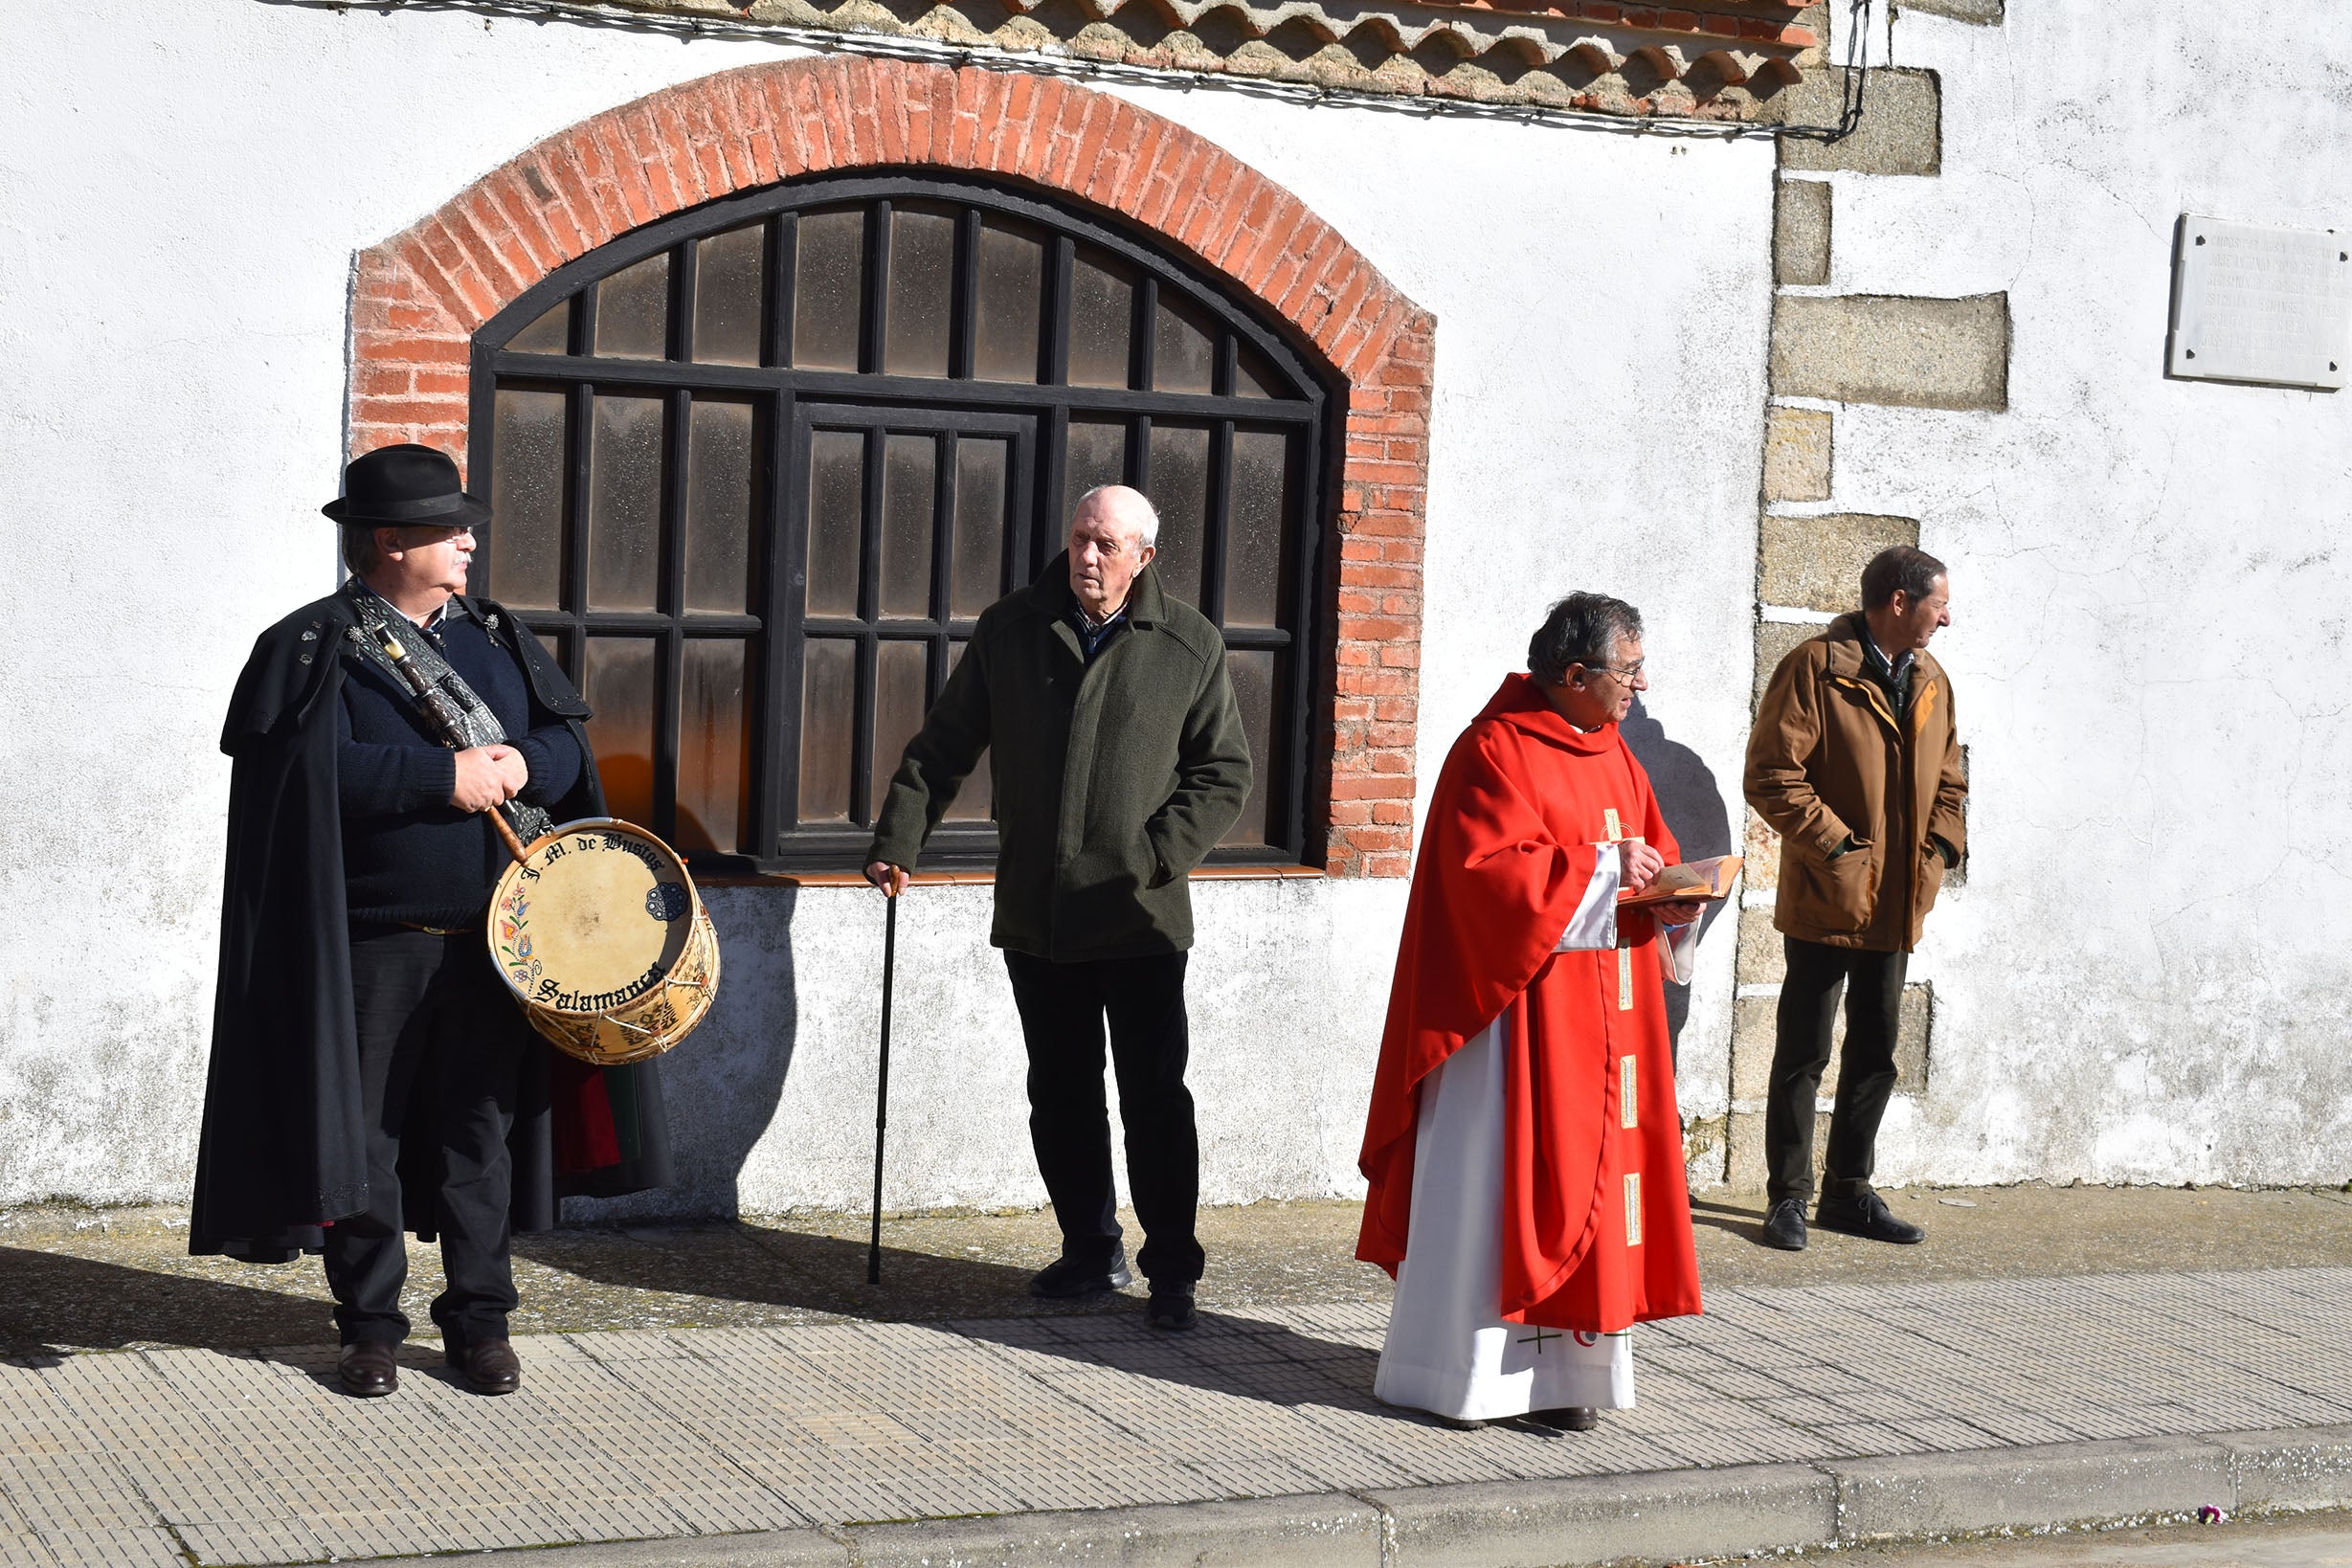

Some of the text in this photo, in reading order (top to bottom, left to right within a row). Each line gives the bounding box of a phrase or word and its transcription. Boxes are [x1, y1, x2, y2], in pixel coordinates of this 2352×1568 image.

[544, 844, 572, 866] M.
[575, 836, 597, 852] de
[601, 831, 666, 872] Bustos
[532, 961, 667, 1013] Salamanca
